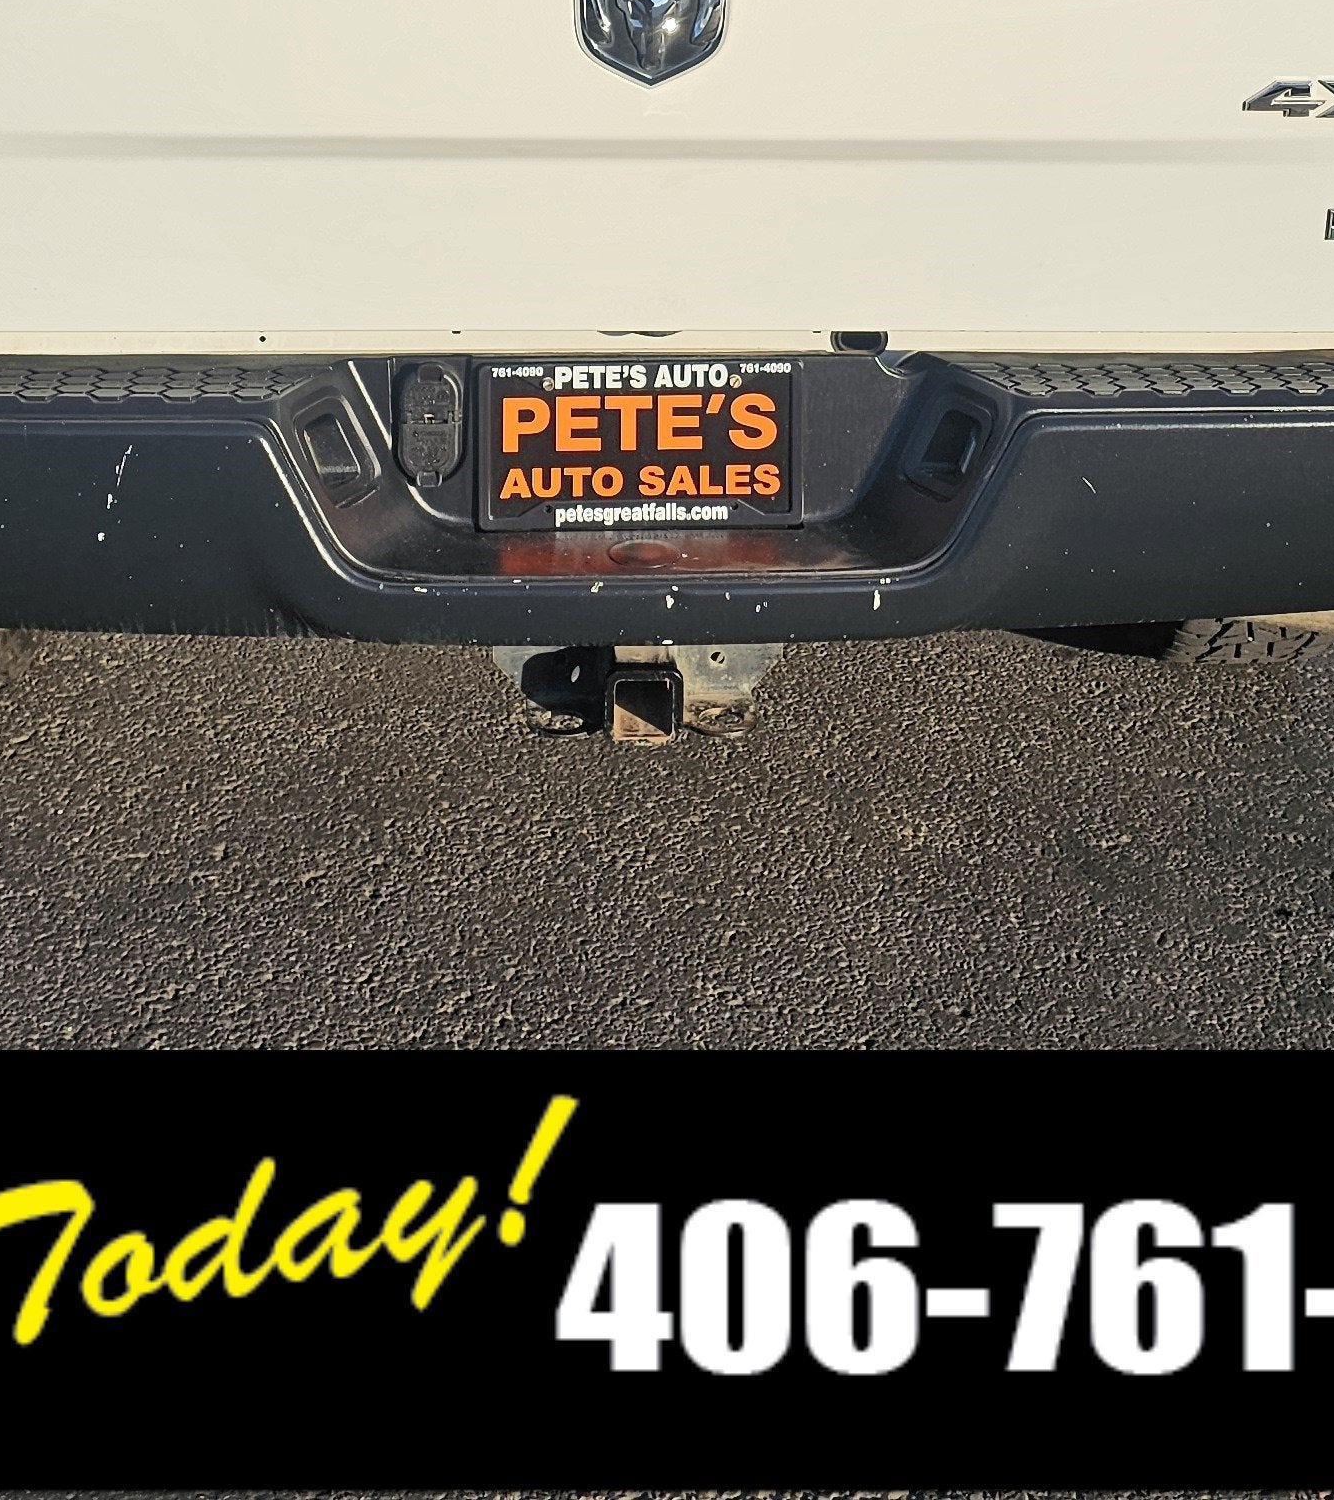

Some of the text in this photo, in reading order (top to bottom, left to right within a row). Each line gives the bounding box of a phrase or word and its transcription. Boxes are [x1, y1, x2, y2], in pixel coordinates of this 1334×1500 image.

[491, 366, 544, 378] 761-4090
[554, 363, 729, 390] PETE'S AUTO
[739, 362, 792, 374] 761-4090
[502, 393, 779, 453] PETE'S
[499, 463, 782, 500] AUTO SALES
[554, 502, 729, 527] petesgreatfalls.com
